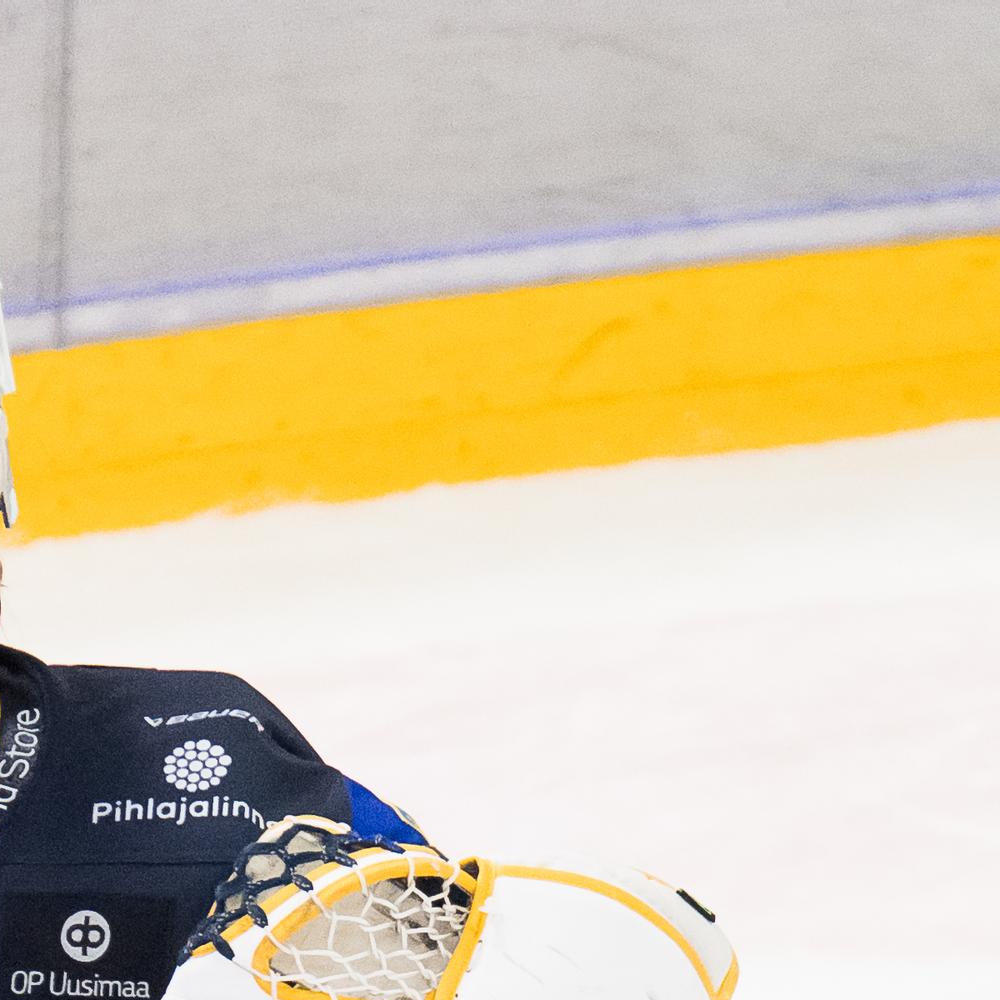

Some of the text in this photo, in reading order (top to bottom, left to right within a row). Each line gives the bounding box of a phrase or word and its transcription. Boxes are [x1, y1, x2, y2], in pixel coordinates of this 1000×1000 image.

[92, 796, 265, 830] Pihlajalinn
[10, 971, 150, 999] OP Uusimaa
